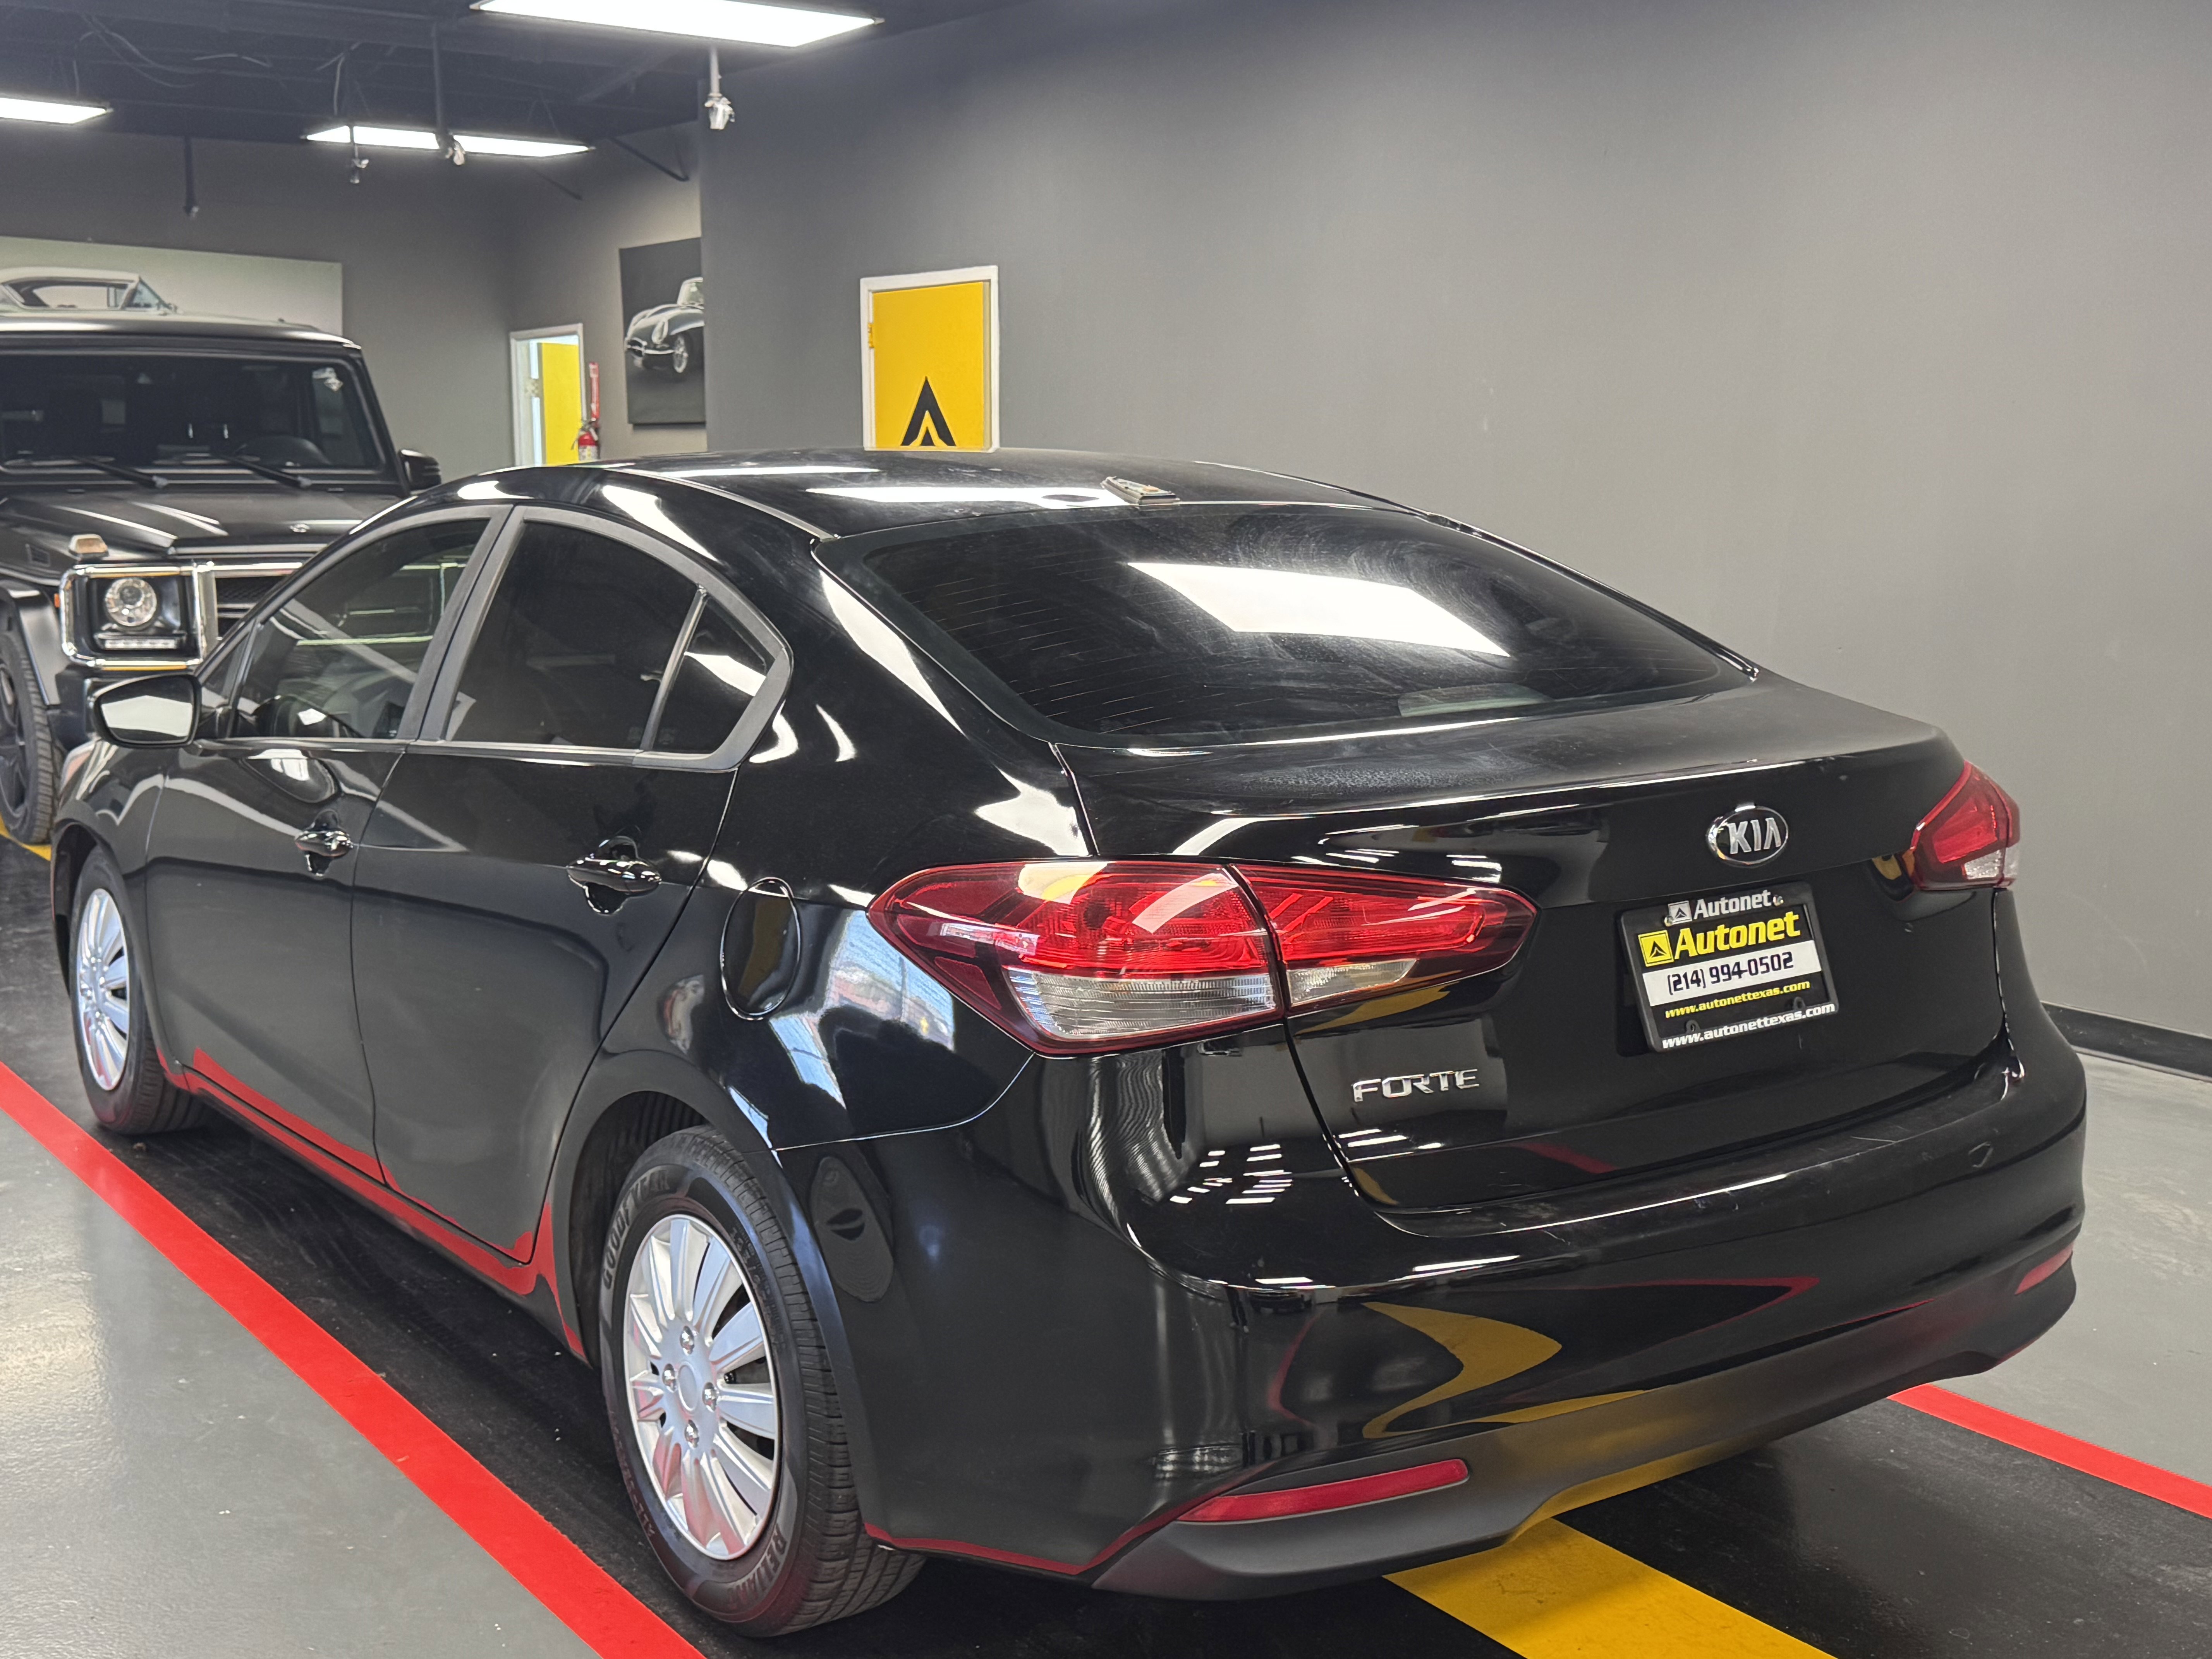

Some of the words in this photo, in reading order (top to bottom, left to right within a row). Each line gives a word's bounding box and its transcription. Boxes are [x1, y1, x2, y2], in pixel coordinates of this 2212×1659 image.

[1728, 817, 1782, 854] KIA
[1693, 889, 1772, 920] Autonet
[1674, 911, 1801, 960] Autonet
[1667, 969, 1706, 996] (214)
[1709, 951, 1794, 985] 994-0502
[1665, 980, 1810, 1018] www.autonettexas.com
[1662, 1003, 1836, 1049] www.autonettexas.com
[1352, 1068, 1480, 1102] FORTE
